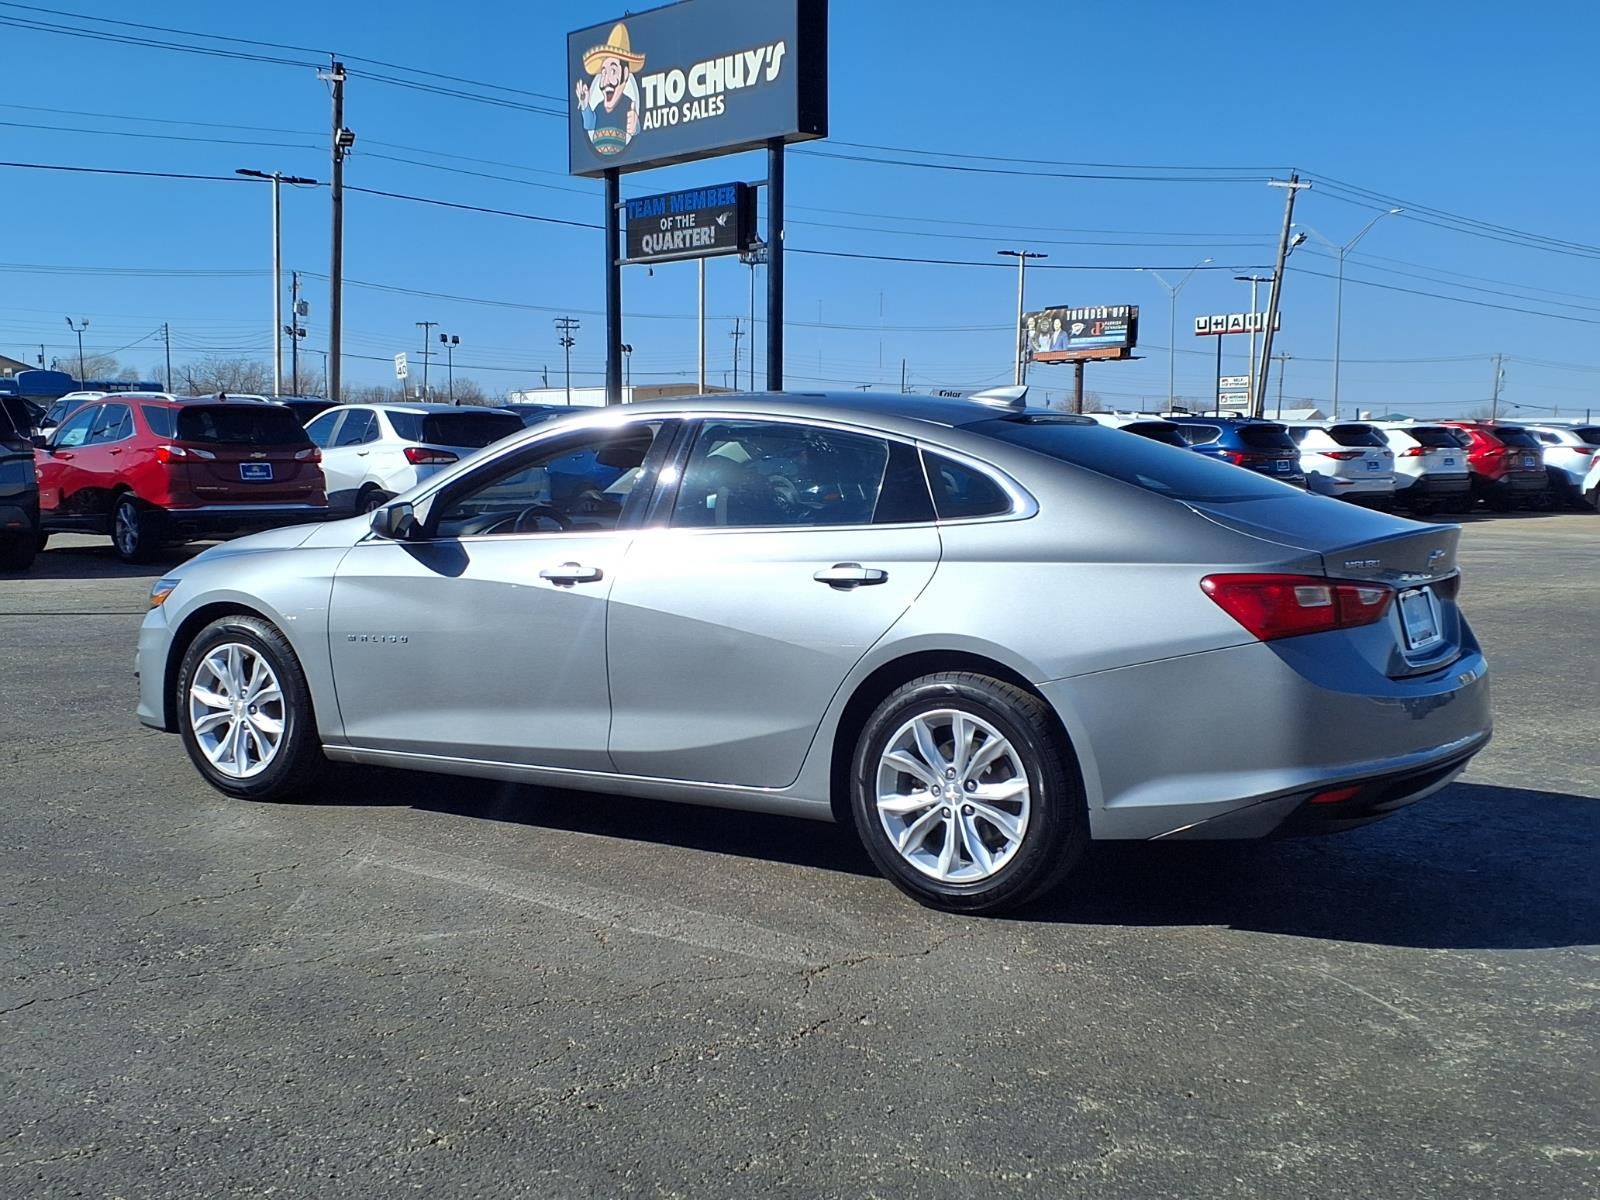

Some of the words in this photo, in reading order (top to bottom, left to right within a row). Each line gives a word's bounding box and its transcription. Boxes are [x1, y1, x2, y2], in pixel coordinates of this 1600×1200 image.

[641, 69, 686, 109] TIO
[688, 41, 786, 98] CHUY'S
[643, 106, 679, 130] AUTO
[682, 94, 725, 123] SALES
[627, 199, 666, 219] TEAM
[669, 186, 736, 212] MEMBER
[660, 217, 673, 231] OF
[676, 213, 696, 229] THE
[641, 226, 715, 254] QUARTER!
